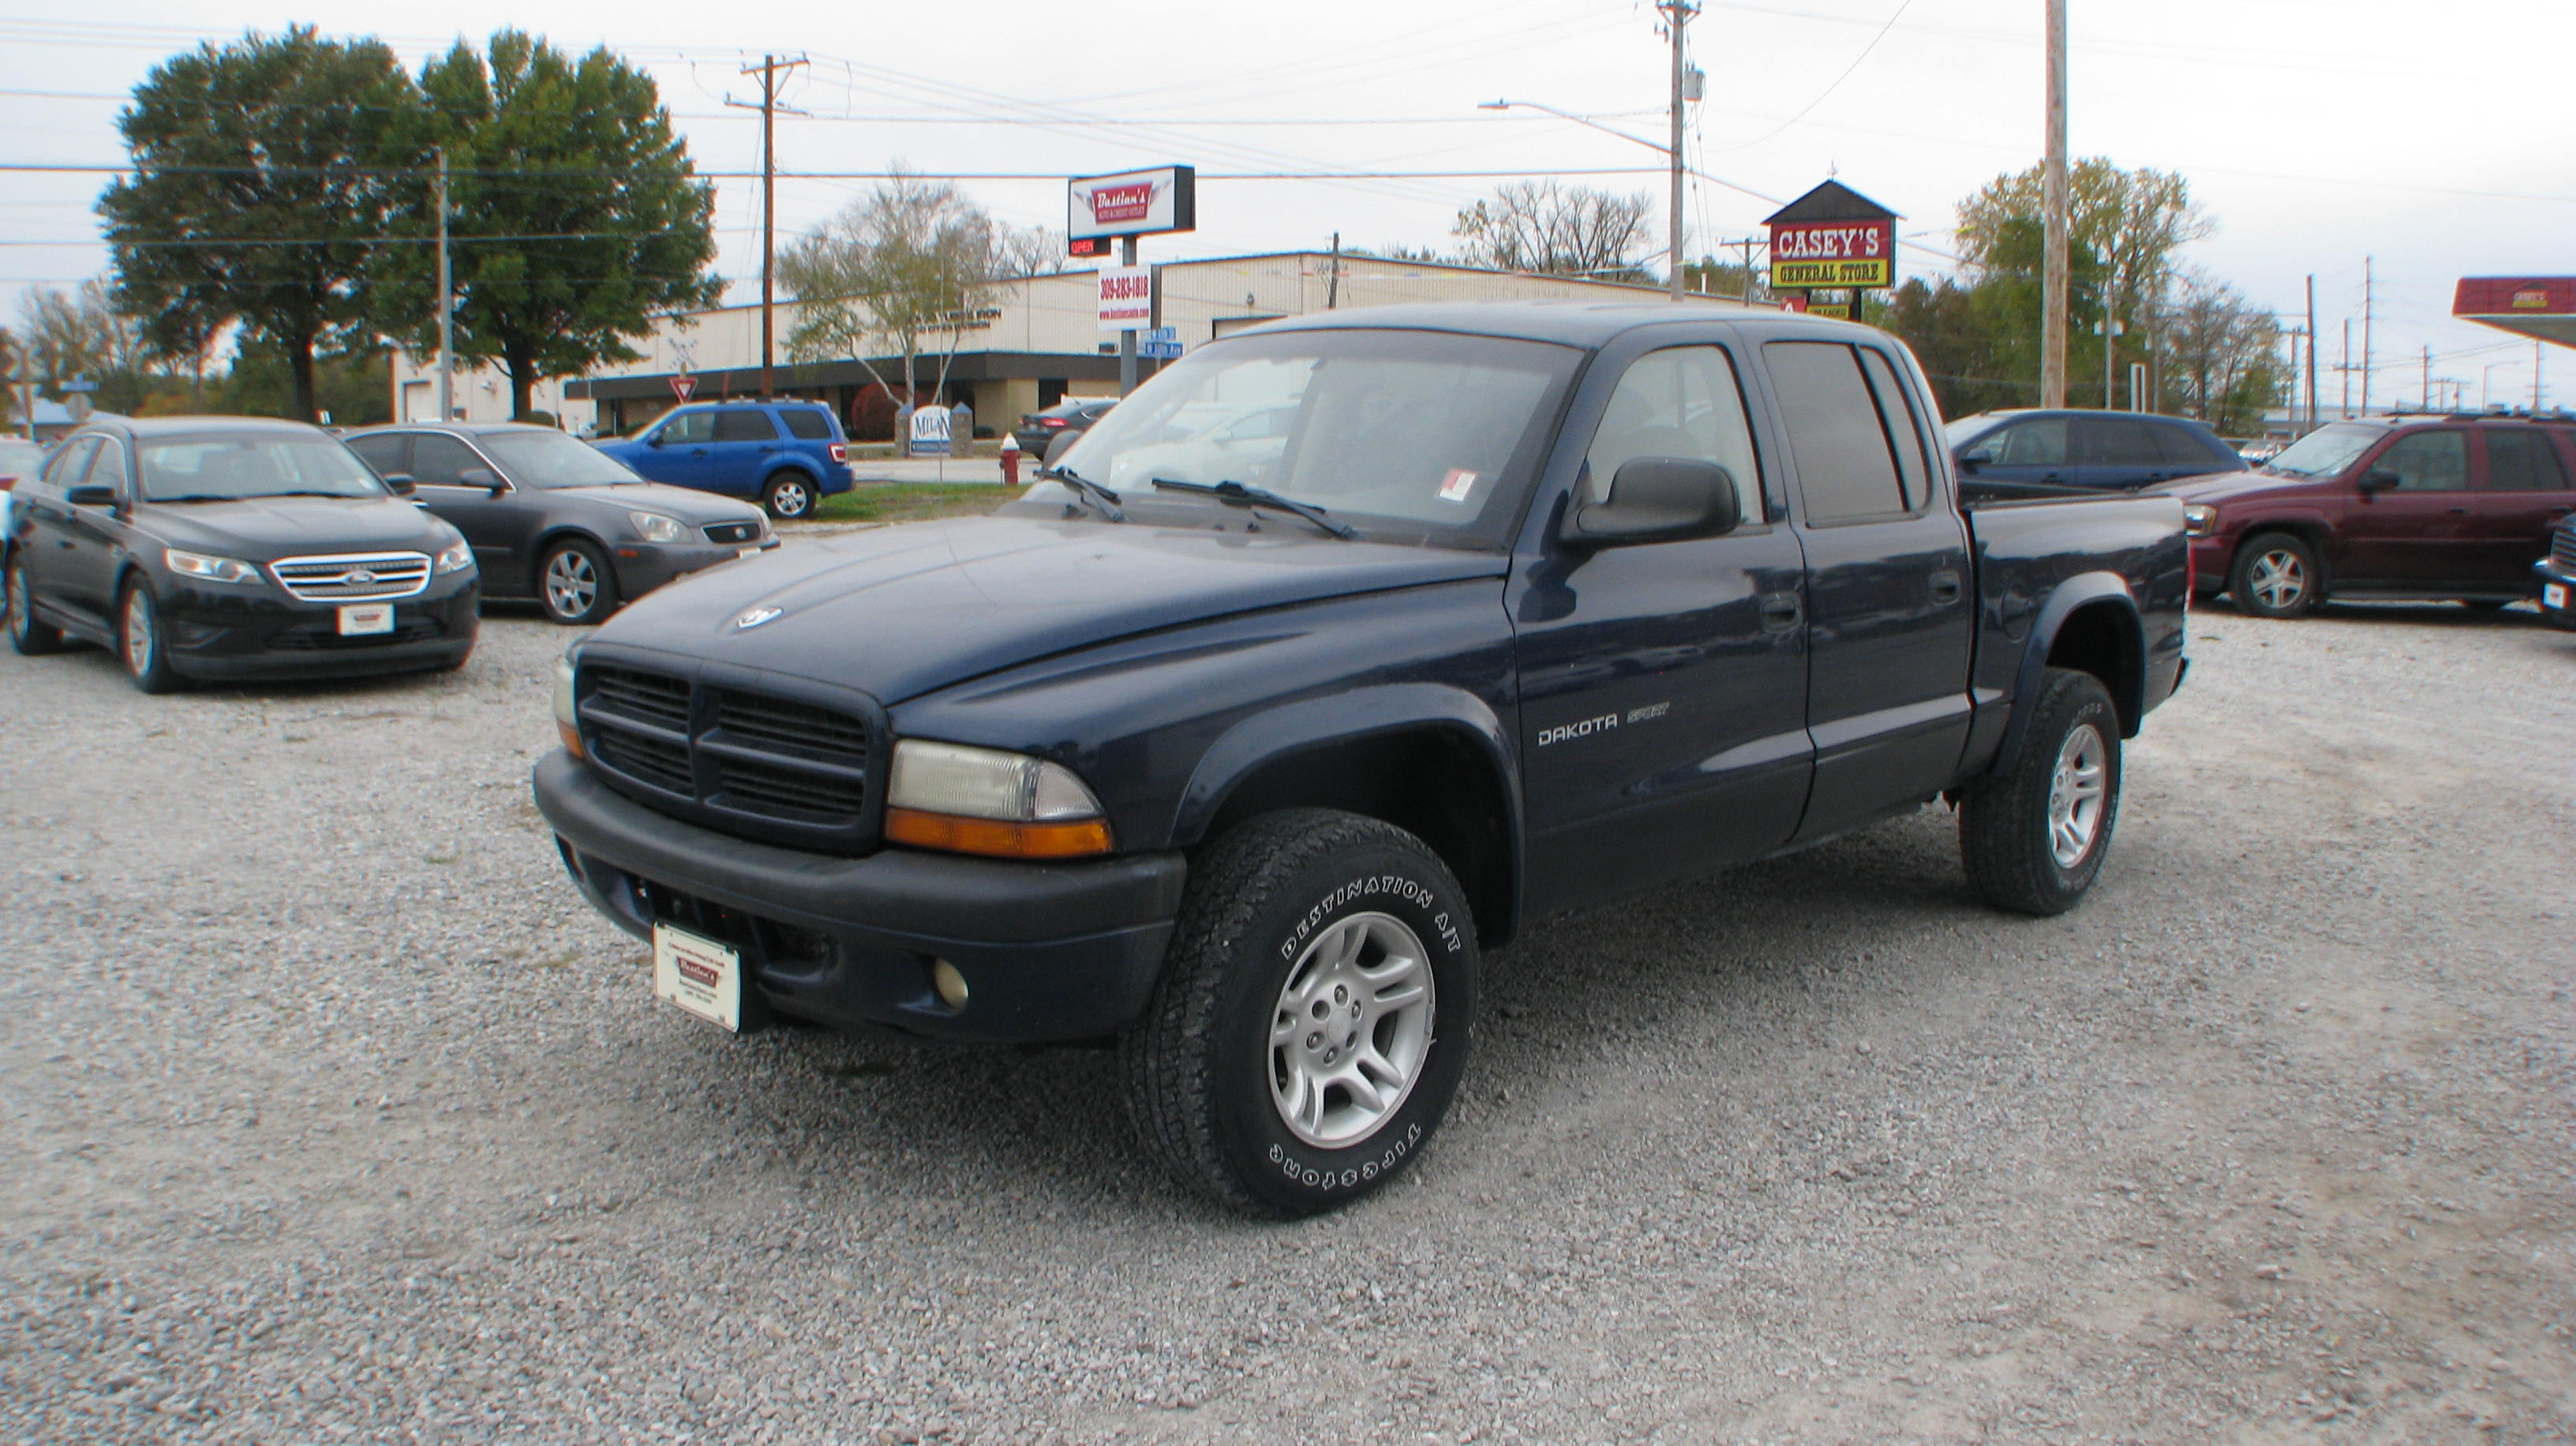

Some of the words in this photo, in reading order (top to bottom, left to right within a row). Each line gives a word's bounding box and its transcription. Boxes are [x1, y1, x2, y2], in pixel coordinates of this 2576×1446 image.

[1071, 240, 1095, 253] OPEN
[1779, 227, 1880, 259] CASEY'S
[1780, 263, 1836, 284] GENERAL
[1839, 262, 1879, 283] STORE
[1100, 275, 1149, 301] 309-283-1818
[915, 416, 951, 440] MILAN
[1538, 713, 1618, 747] DAKOTA
[1281, 875, 1433, 960] DESTINATION
[1434, 912, 1461, 952] A/T
